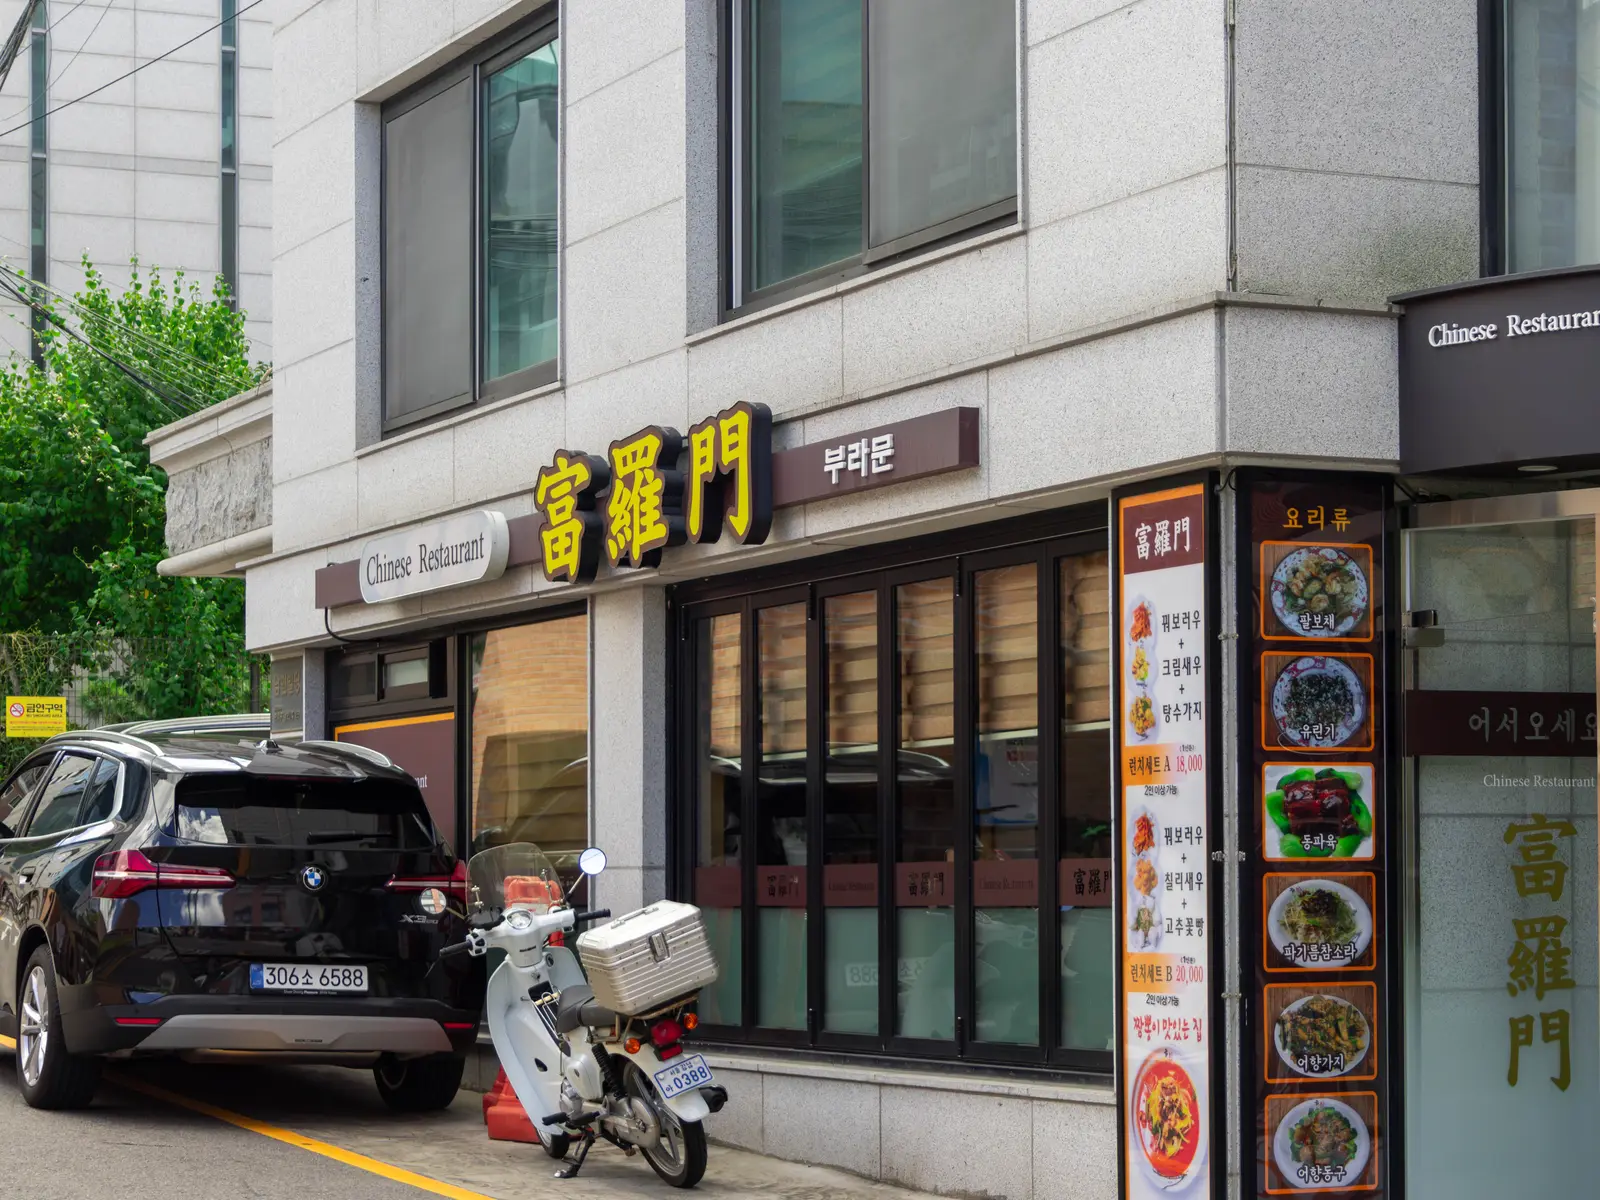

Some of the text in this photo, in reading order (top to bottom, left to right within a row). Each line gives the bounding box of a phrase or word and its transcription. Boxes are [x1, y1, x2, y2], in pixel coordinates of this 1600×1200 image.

[1428, 322, 1498, 348] Chinese
[823, 432, 896, 485] 부라문
[537, 409, 753, 577] 富羅門
[1282, 505, 1352, 533] 요리류
[1134, 516, 1191, 560] 富羅門
[366, 531, 485, 586] Chinese Restaurant
[1161, 610, 1201, 633] 꿔보러우
[1299, 612, 1335, 631] 팔보채
[1162, 655, 1202, 677] 크림새우
[26, 703, 63, 713] 금연구역
[1162, 701, 1202, 724] 탕수가지
[1300, 722, 1336, 741] 유린기
[1128, 753, 1203, 776] 런치세트 A 18,000
[1483, 774, 1596, 788] Chinese Restaurant
[1164, 825, 1203, 846] 꿔보러우
[1301, 833, 1338, 851] 동파육
[1164, 871, 1204, 892] 칠리새우
[1165, 917, 1205, 937] 고추꽃빵
[1284, 943, 1356, 962] 파기름참소라
[1502, 813, 1578, 1093] 富羅門
[265, 966, 314, 986] 306소
[319, 967, 364, 987] 6588
[1130, 963, 1204, 985] 런치세트 B 20,000
[1162, 1017, 1190, 1041] 맛있는
[1192, 1018, 1202, 1043] 집
[1297, 1054, 1344, 1072] 어향가지
[673, 1066, 708, 1089] 0388
[1298, 1165, 1347, 1183] 어향동구
